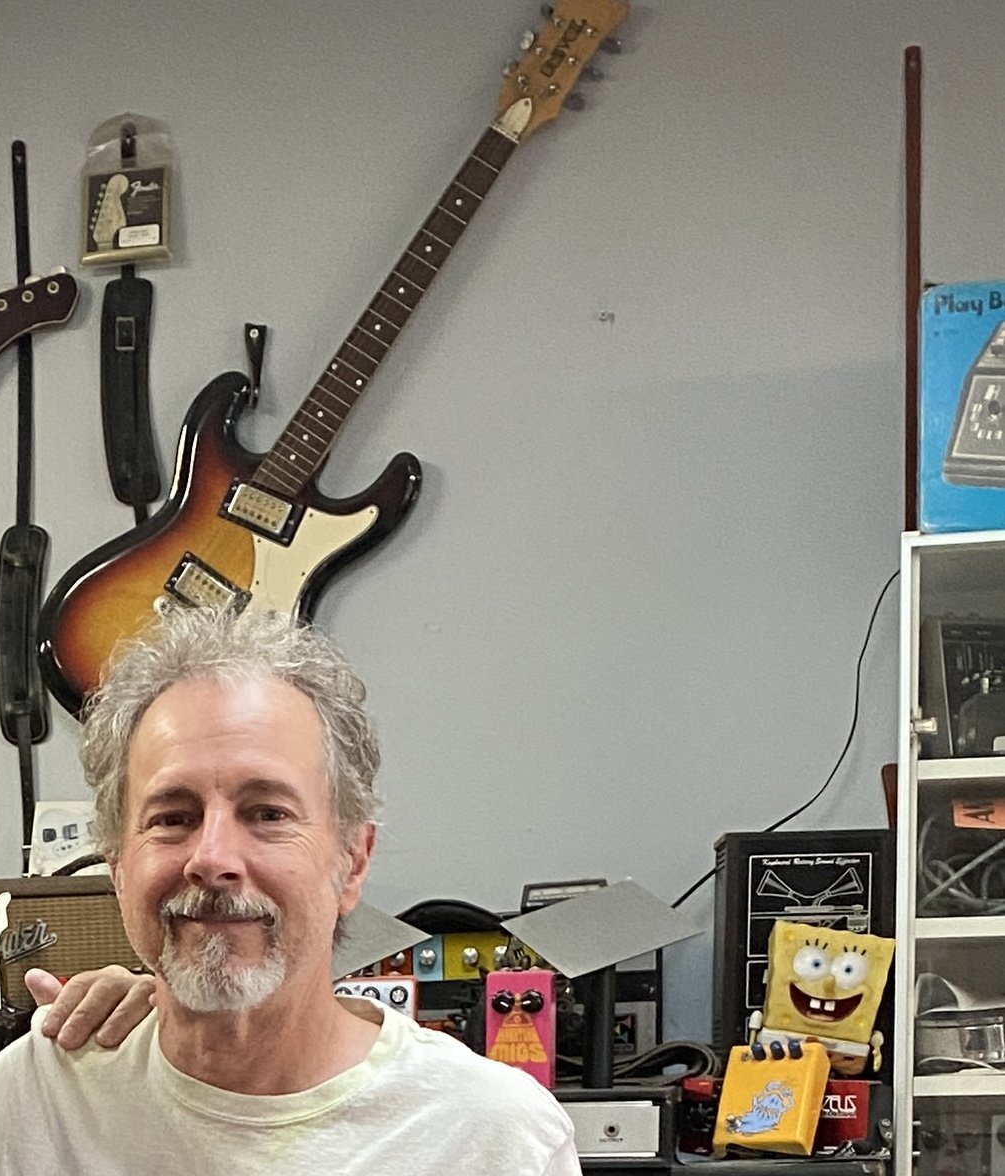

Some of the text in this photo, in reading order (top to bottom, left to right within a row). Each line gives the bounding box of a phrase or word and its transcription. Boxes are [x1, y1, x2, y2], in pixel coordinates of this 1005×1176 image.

[934, 291, 1005, 316] Play B
[822, 1095, 857, 1112] ZEUS
